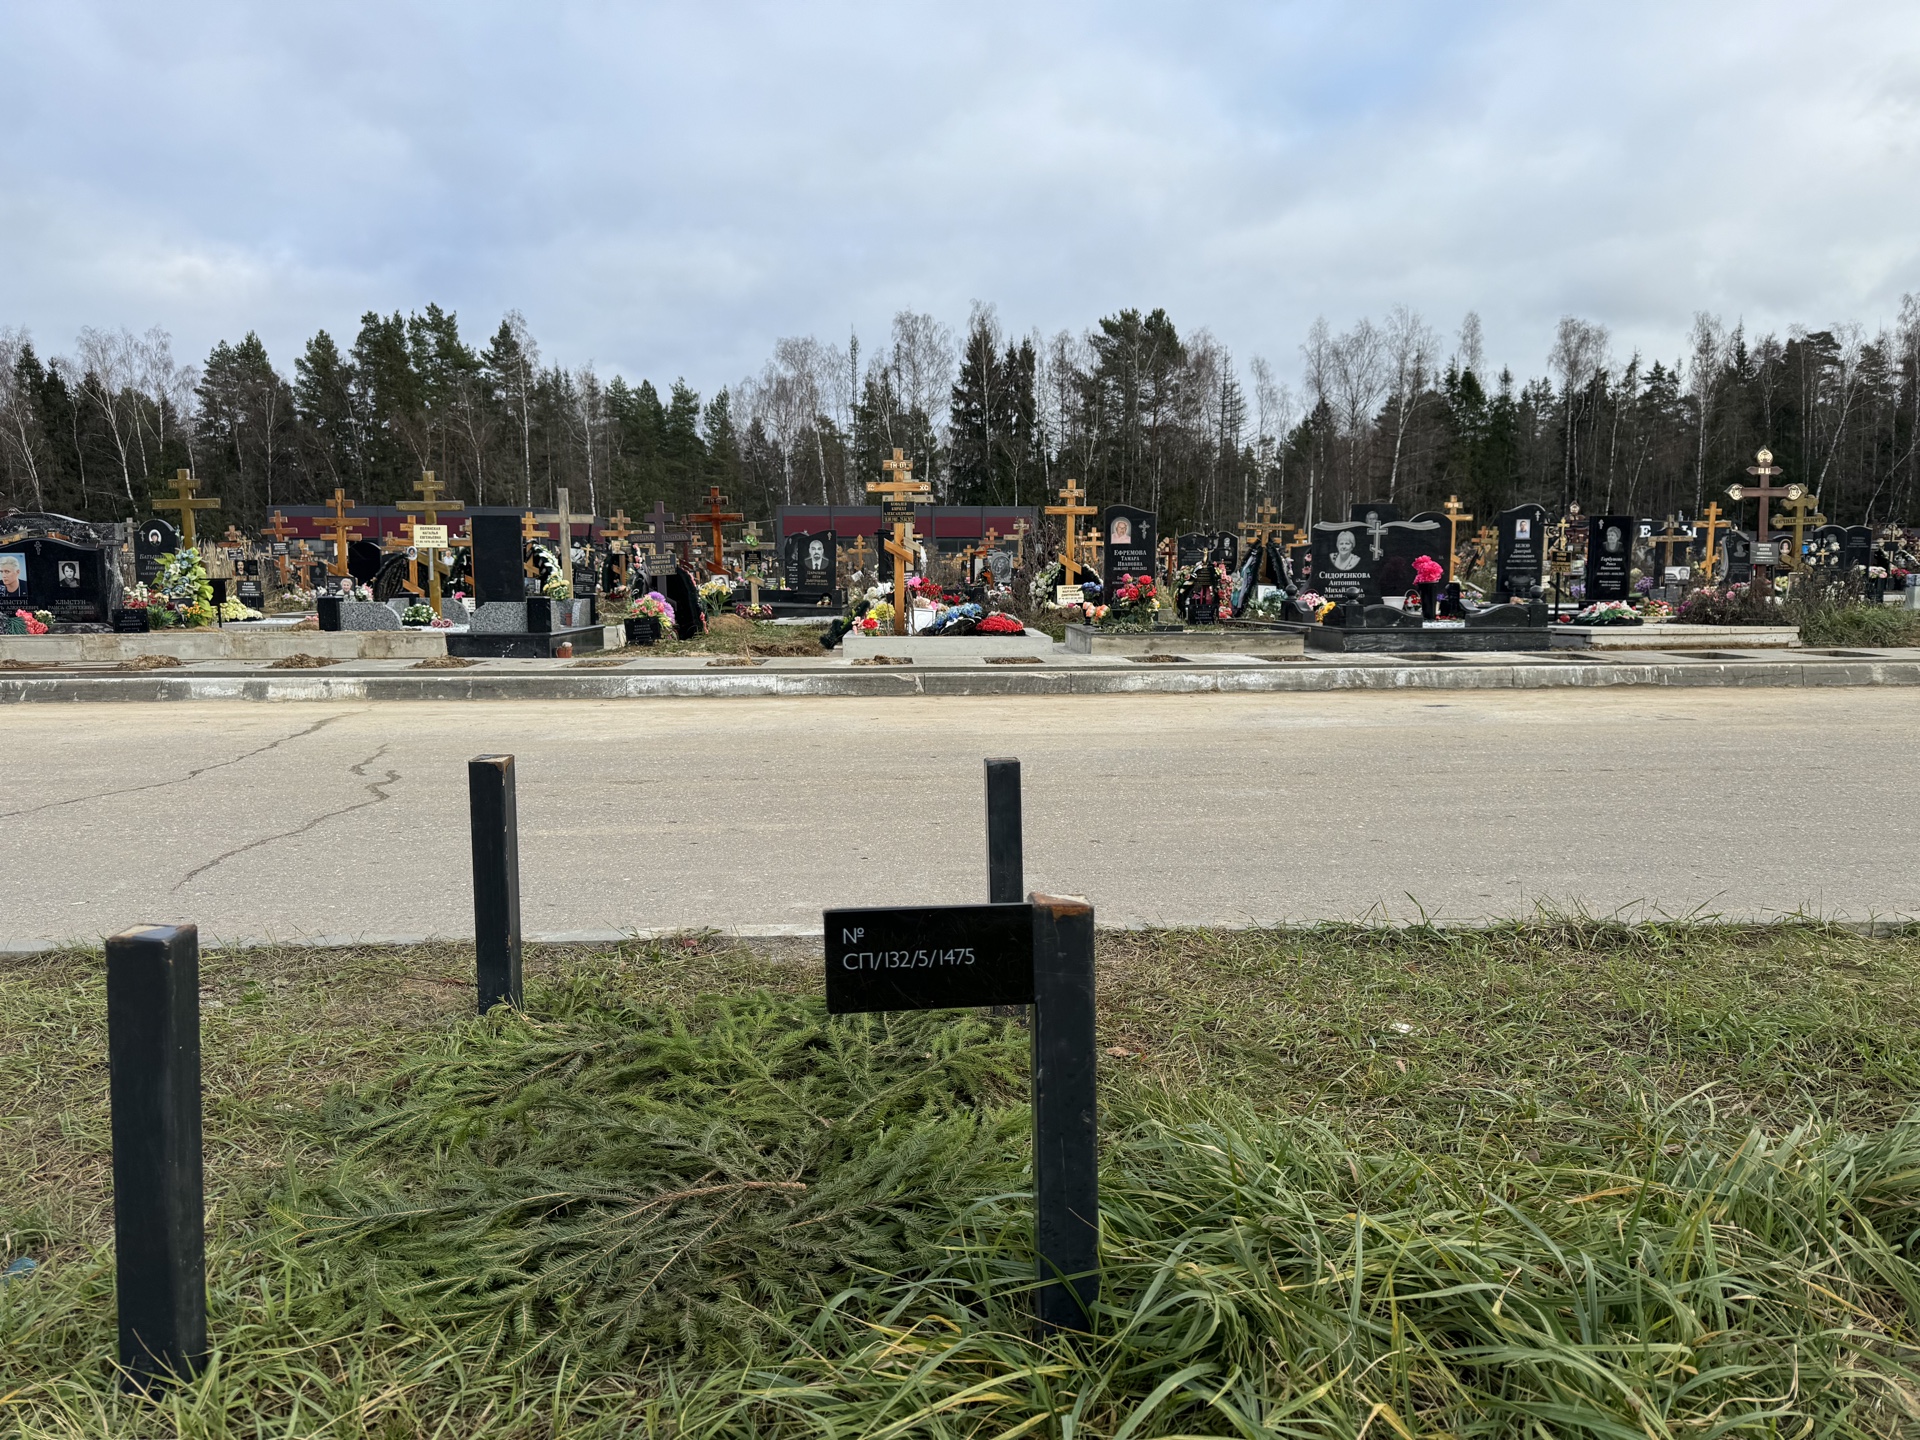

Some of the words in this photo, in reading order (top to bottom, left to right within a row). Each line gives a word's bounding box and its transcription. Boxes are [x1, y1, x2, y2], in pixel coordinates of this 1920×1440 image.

[1318, 570, 1371, 579] СИДОРЕНКОВА
[843, 927, 865, 944] №
[843, 948, 976, 971] СП/132/5/1475
